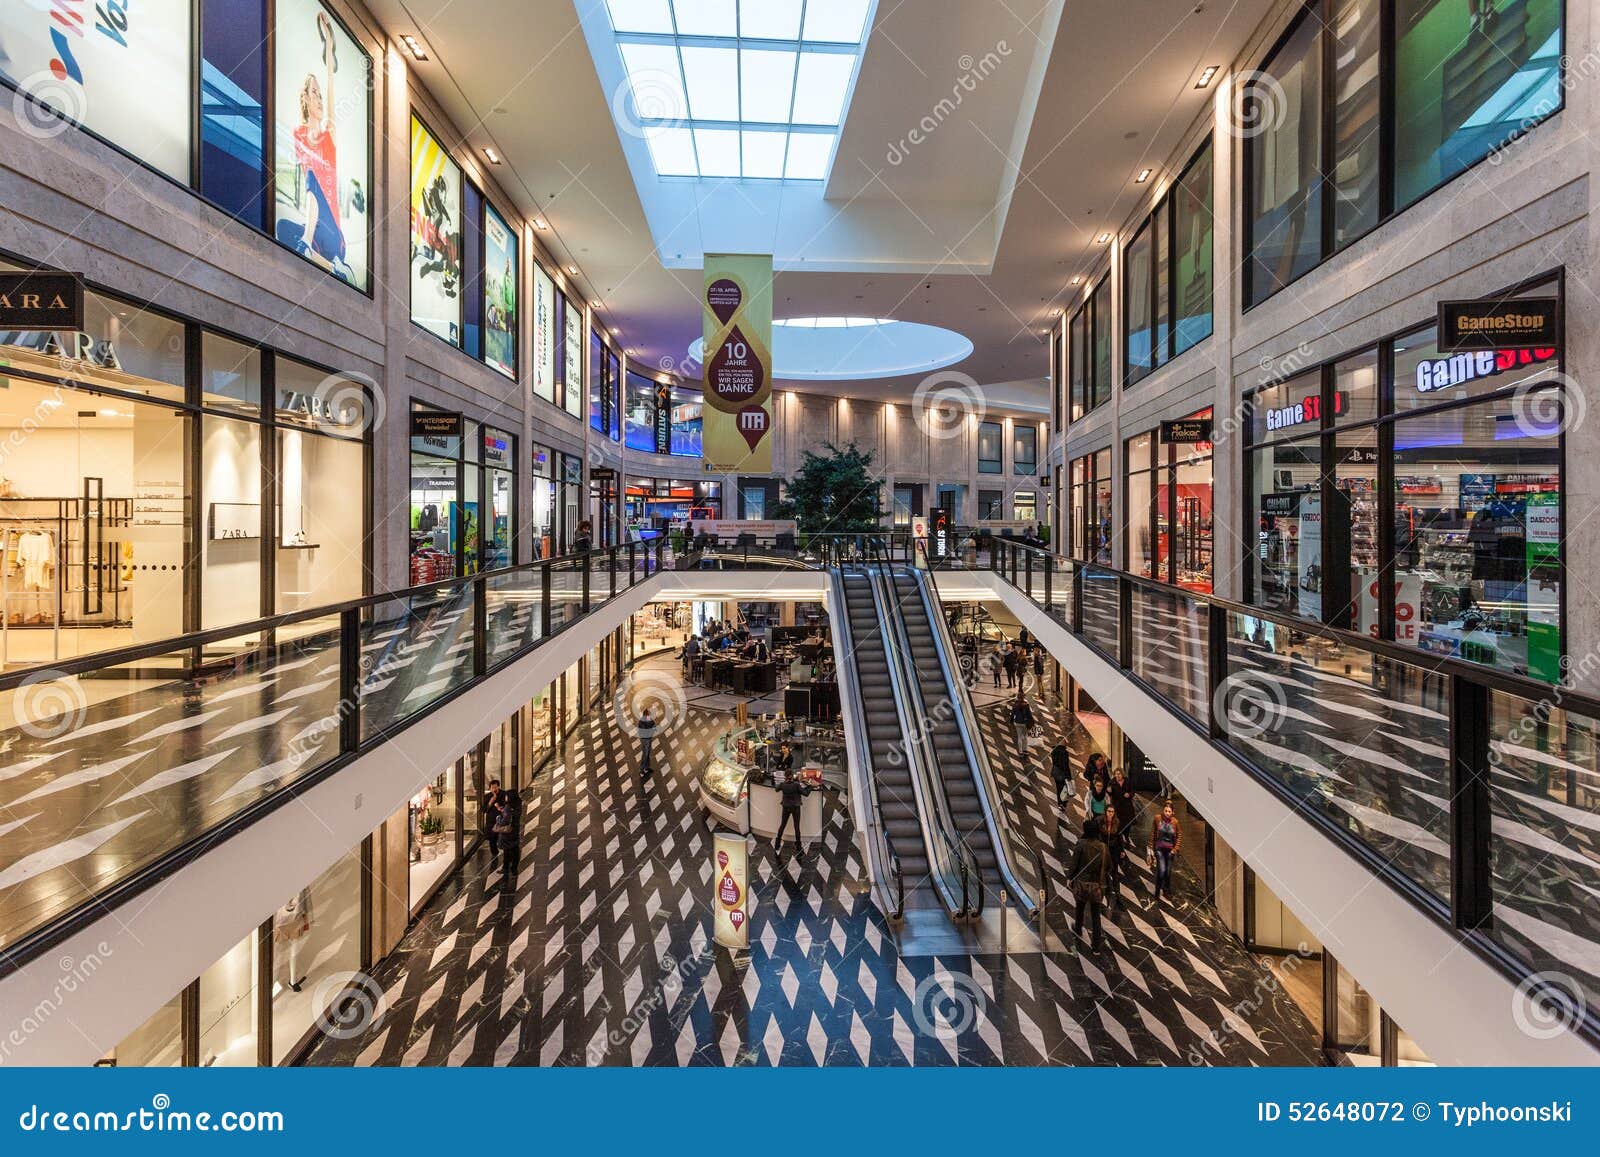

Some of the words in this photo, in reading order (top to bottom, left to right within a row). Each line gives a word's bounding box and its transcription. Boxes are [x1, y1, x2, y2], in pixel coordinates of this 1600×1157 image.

[1457, 313, 1544, 329] GameStop
[725, 342, 747, 359] 10
[718, 384, 754, 393] DANKE
[285, 391, 334, 420] ZARA
[1266, 391, 1342, 430] GameSt
[658, 408, 667, 450] SATURN
[222, 529, 249, 539] ZARA
[1370, 624, 1414, 639] SLE
[723, 877, 733, 886] 10
